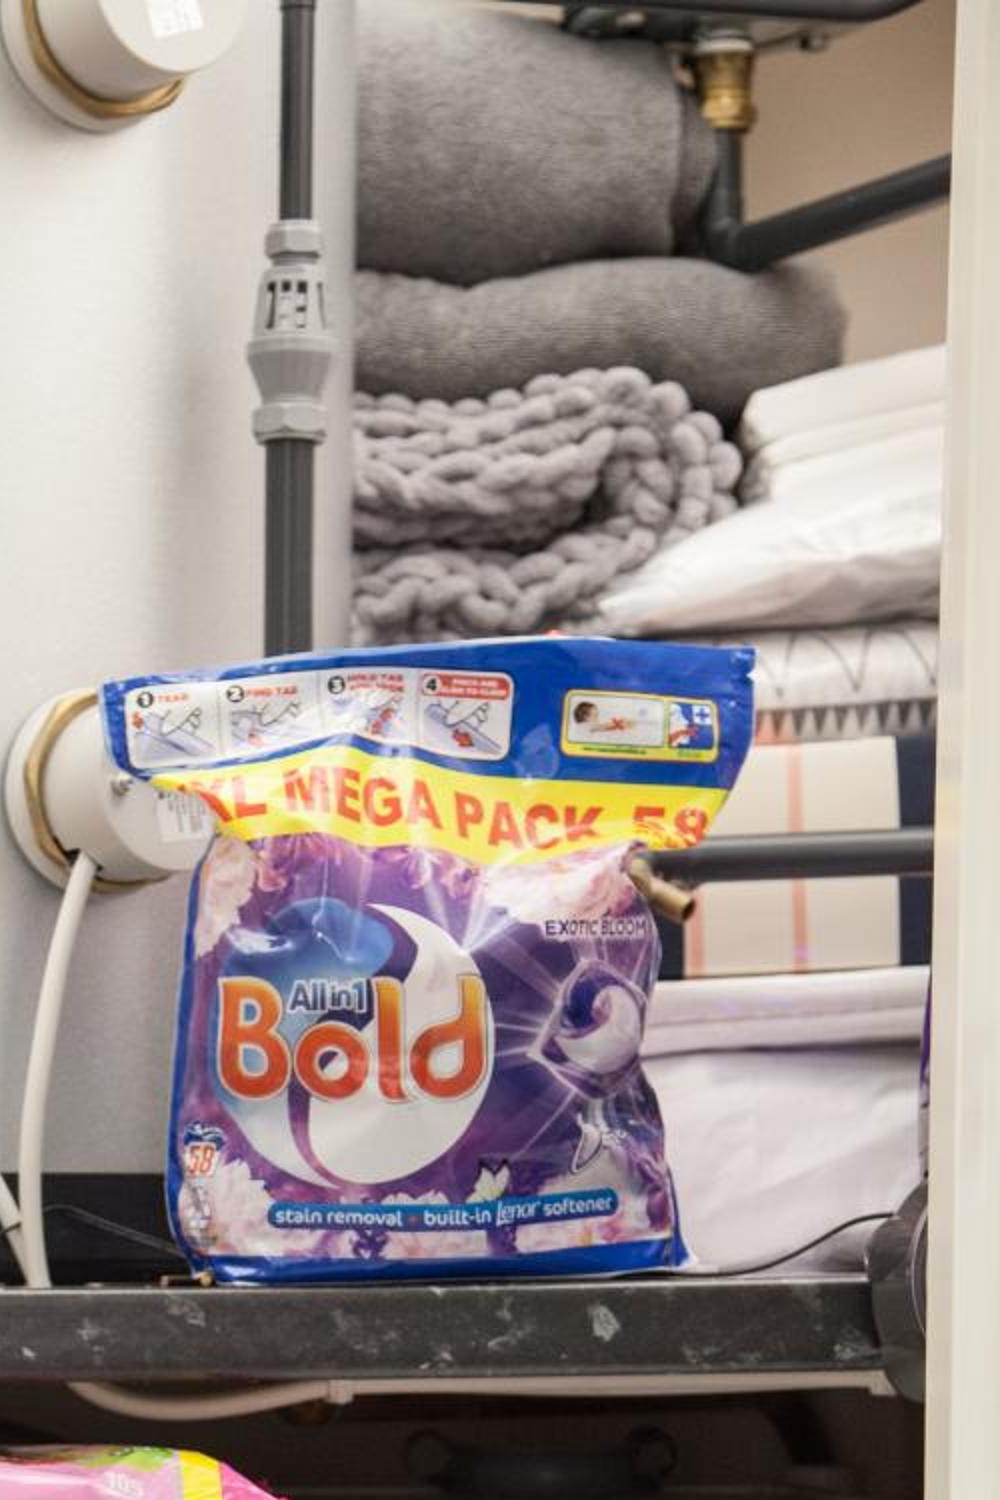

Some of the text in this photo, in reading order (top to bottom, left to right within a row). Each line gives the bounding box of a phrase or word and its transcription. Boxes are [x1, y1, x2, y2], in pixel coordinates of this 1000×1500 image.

[426, 677, 437, 692] 4
[283, 766, 443, 831] MEGA
[454, 790, 603, 851] PACK
[544, 918, 647, 936] EXOTIC BLOOM
[287, 979, 368, 1014] All in 1
[216, 974, 489, 1103] Bold
[188, 1145, 216, 1175] 58
[274, 1207, 323, 1225] stain
[326, 1208, 404, 1228] removal
[423, 1203, 492, 1228] built-in
[541, 1194, 614, 1216] softener
